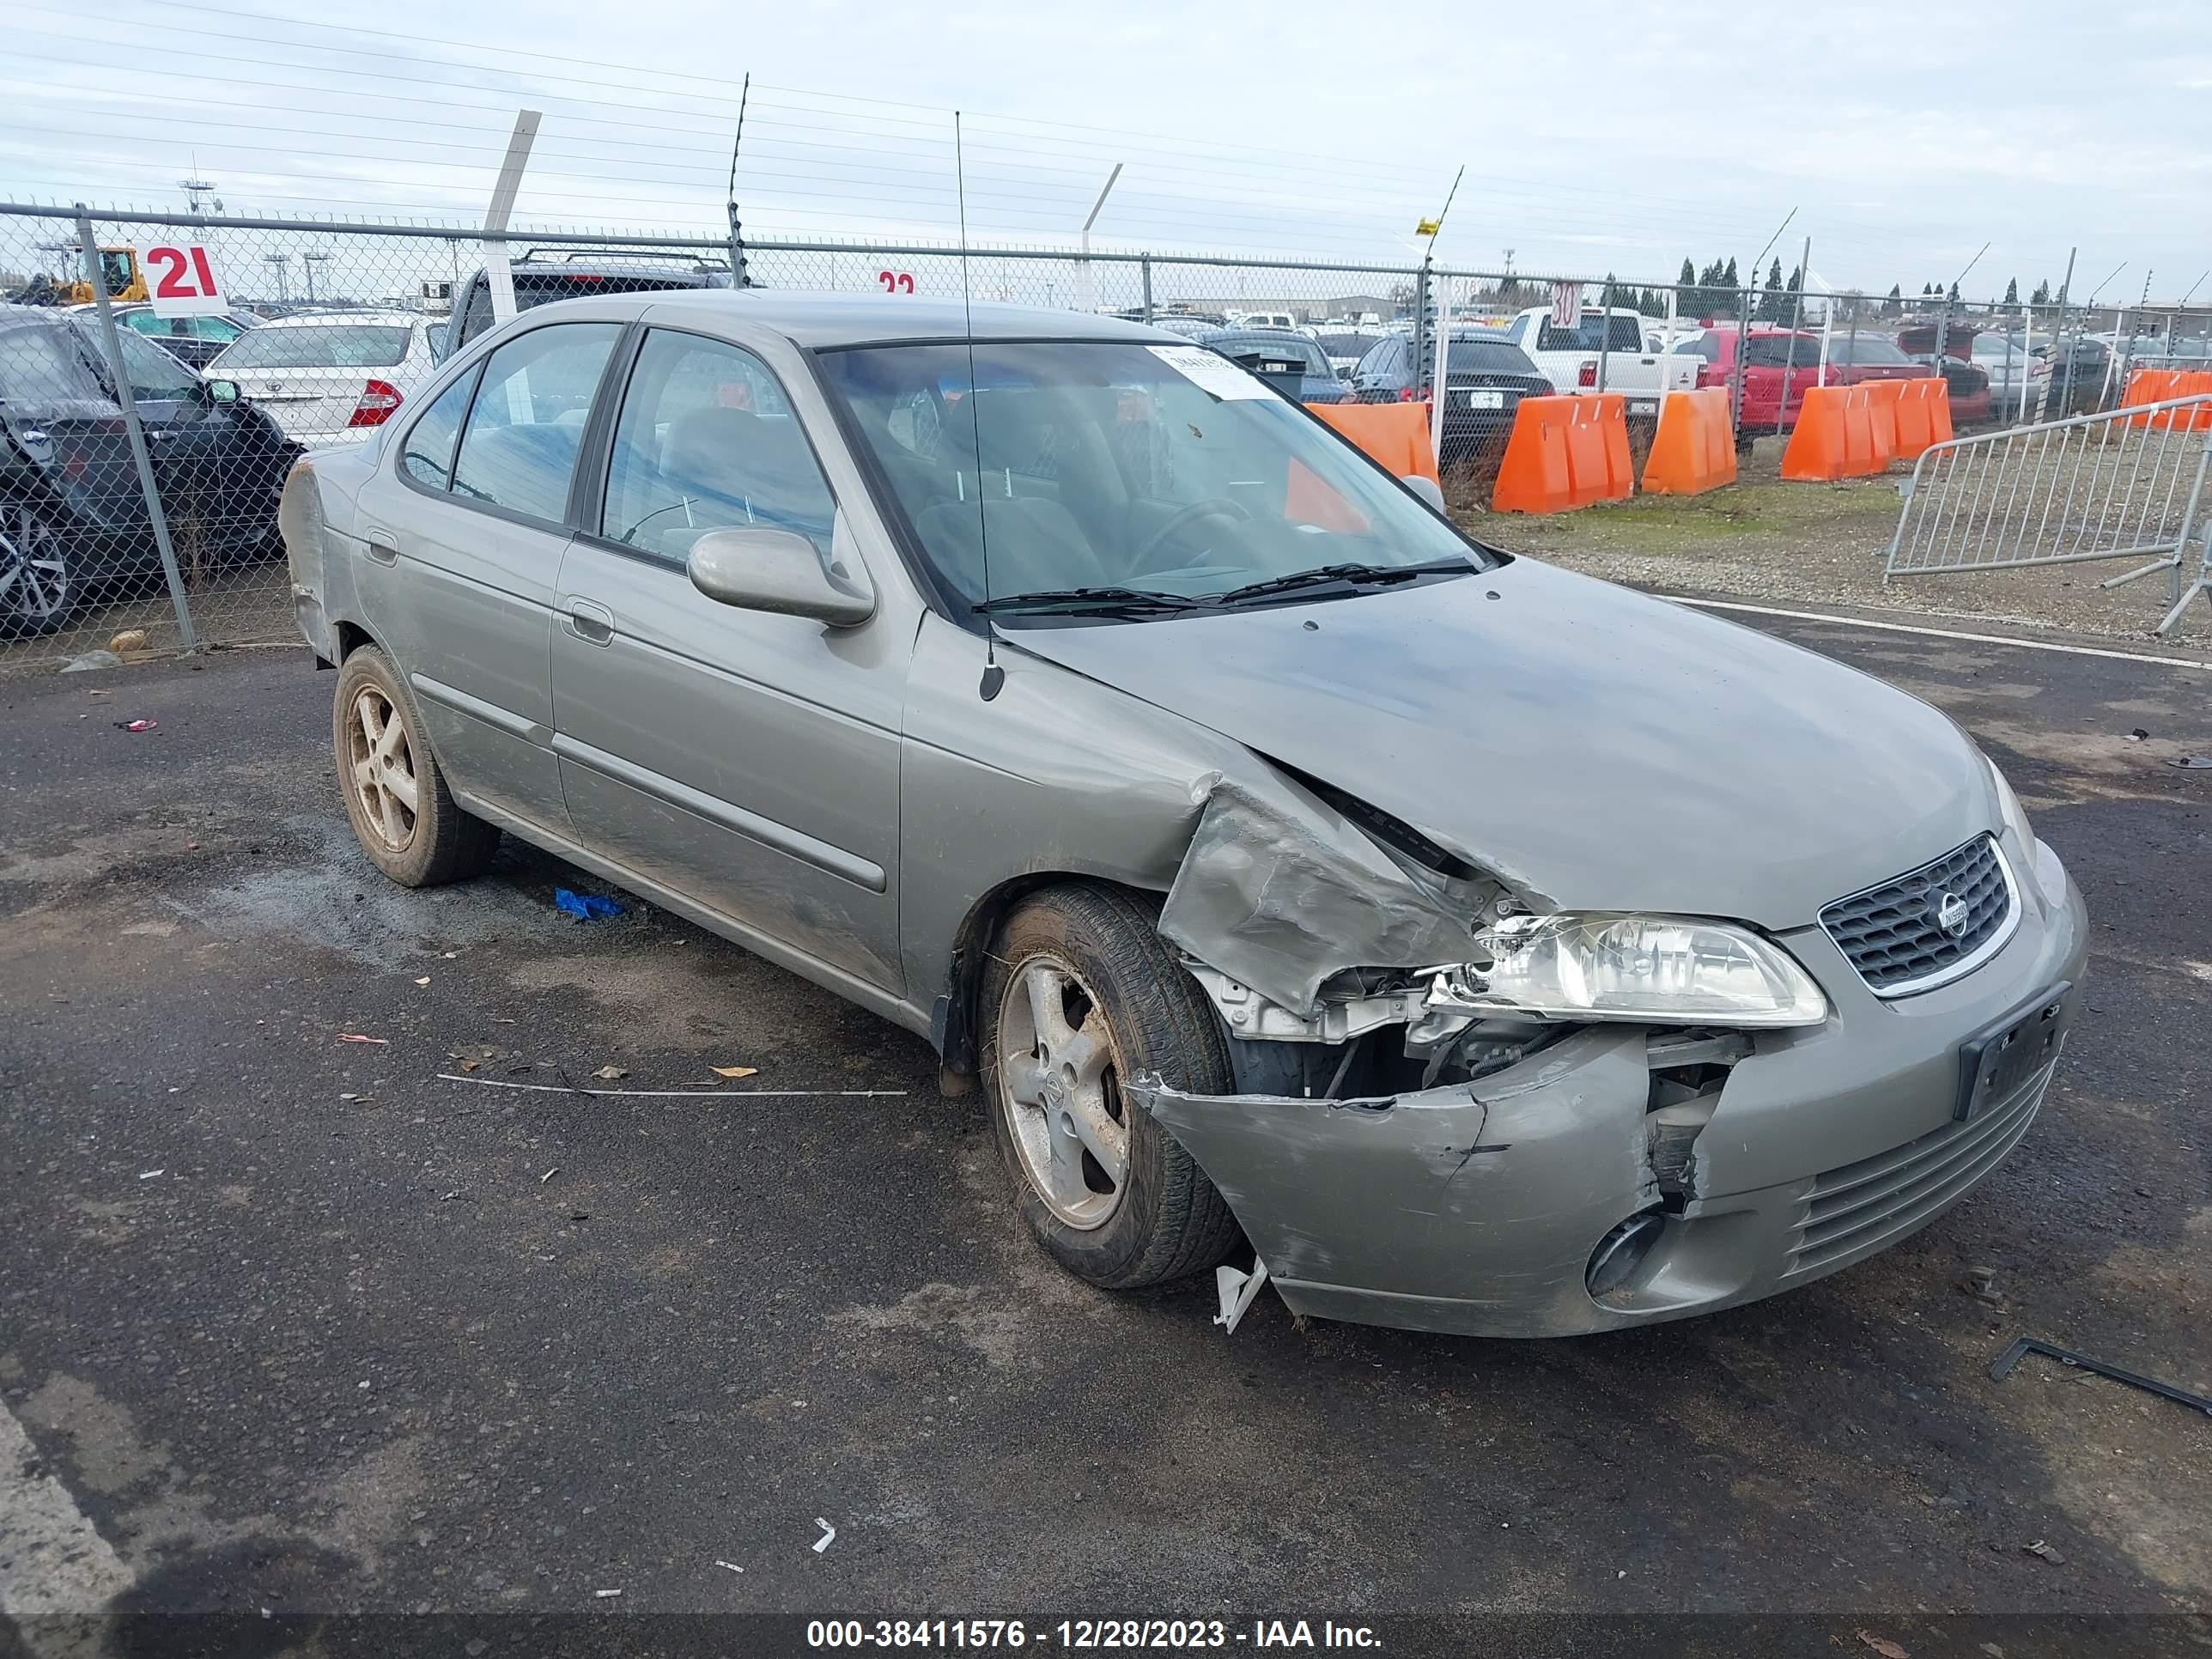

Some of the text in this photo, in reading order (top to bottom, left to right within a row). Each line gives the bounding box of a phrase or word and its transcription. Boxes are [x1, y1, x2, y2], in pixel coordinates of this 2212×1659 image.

[147, 246, 218, 298] 21
[1553, 281, 1574, 325] 30
[1945, 904, 1967, 924] NISSAN
